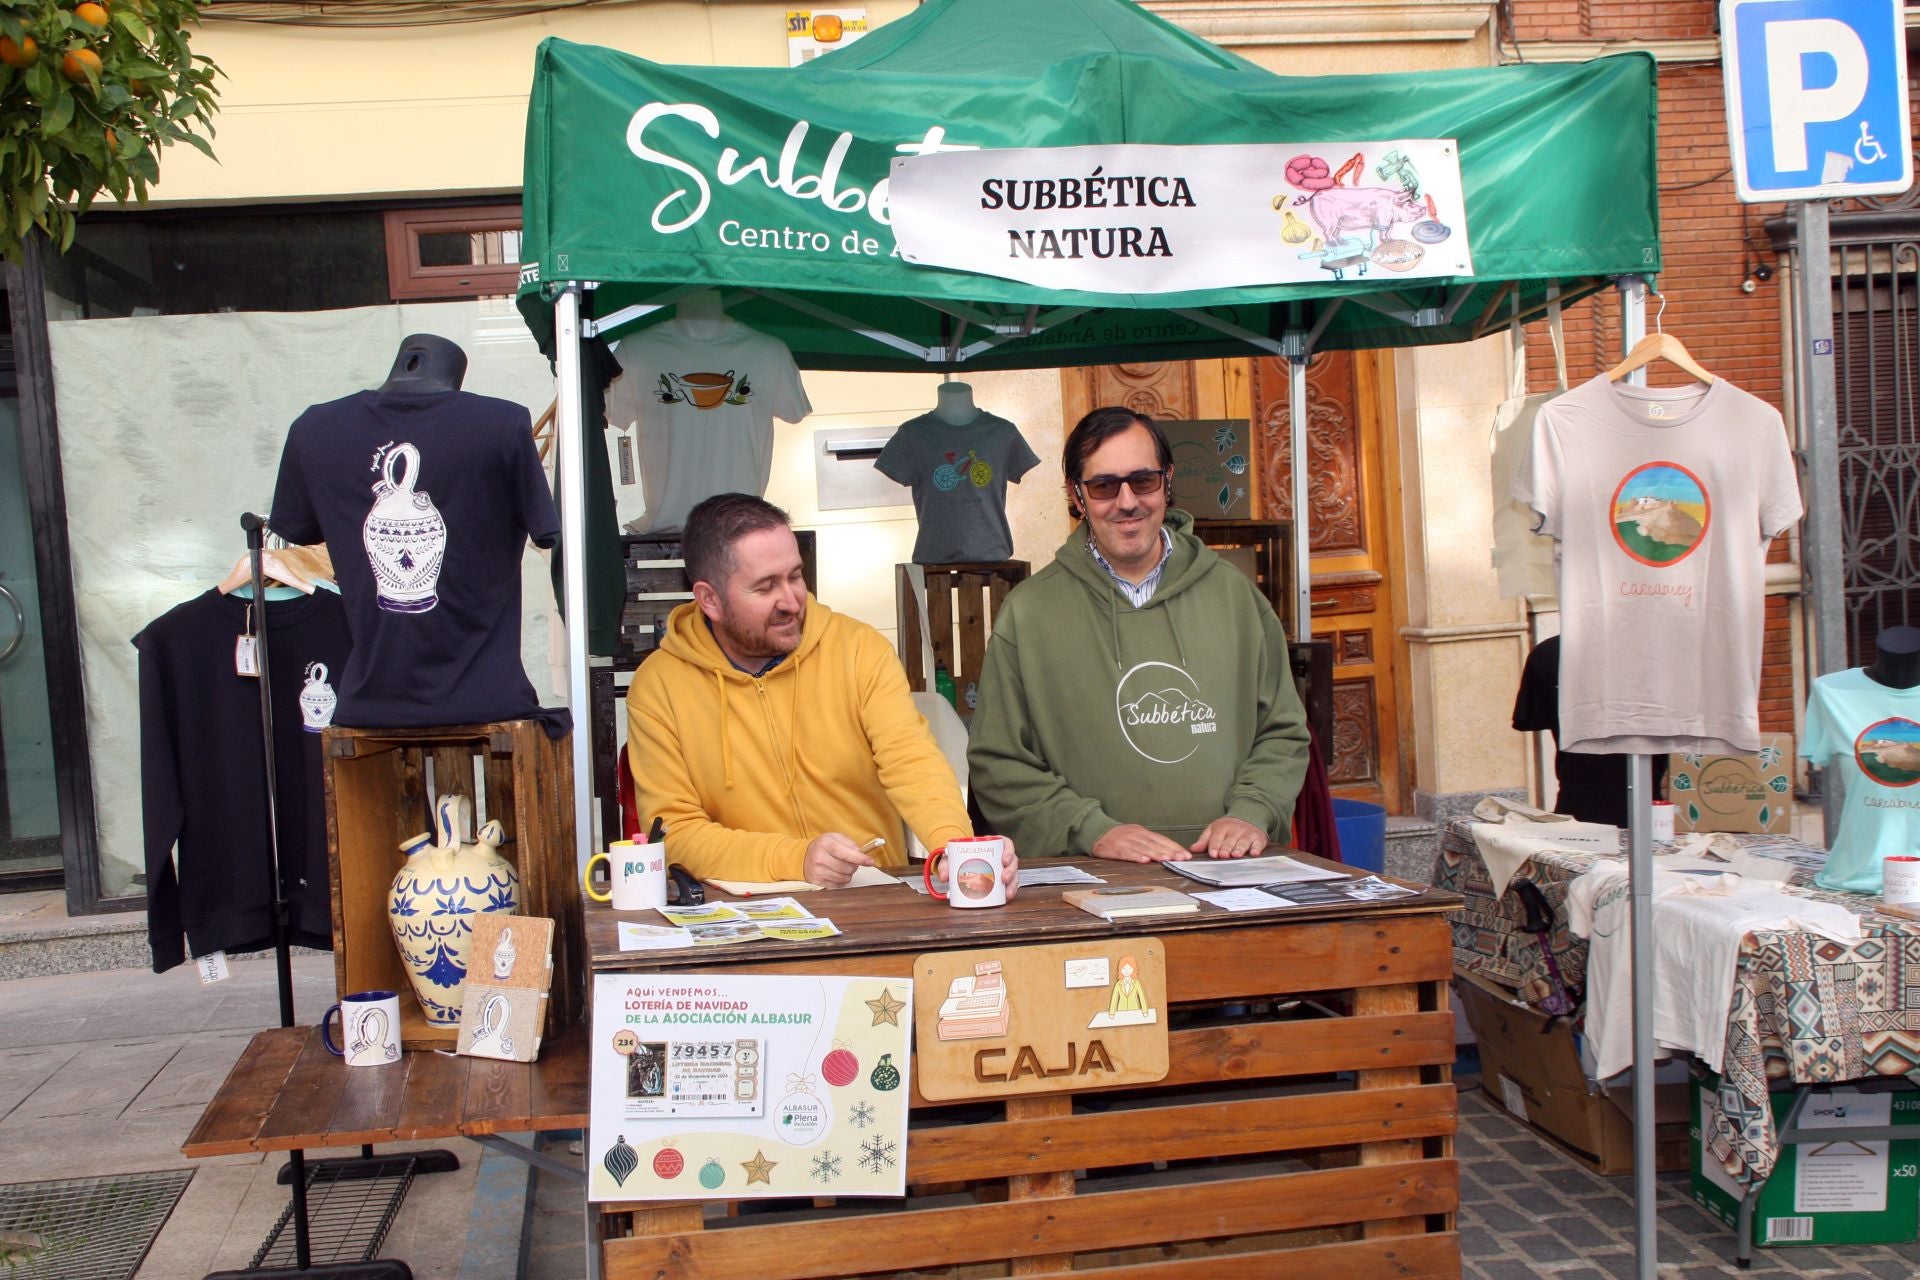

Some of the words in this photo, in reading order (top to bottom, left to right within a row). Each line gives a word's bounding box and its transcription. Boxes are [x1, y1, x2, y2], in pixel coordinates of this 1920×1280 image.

[1764, 18, 1869, 173] P
[981, 165, 1197, 211] SUBBÉTICA
[719, 220, 830, 252] Centro
[841, 230, 879, 256] de
[1007, 226, 1174, 260] NATURA
[1126, 701, 1216, 726] Subbética
[1190, 722, 1217, 734] natura
[624, 861, 645, 877] NO
[625, 999, 673, 1010] LOTERÍA
[676, 1001, 691, 1010] DE
[694, 1001, 749, 1011] NAVIDAD
[625, 1014, 641, 1024] DE
[644, 1014, 659, 1024] LA
[662, 1011, 747, 1024] ASOCIACIÓN
[750, 1013, 812, 1024] ALBASUR
[974, 1039, 1116, 1084] CAJA
[783, 1104, 818, 1112] ALBASUR
[794, 1114, 818, 1122] Plena
[1893, 1164, 1917, 1177] x50
